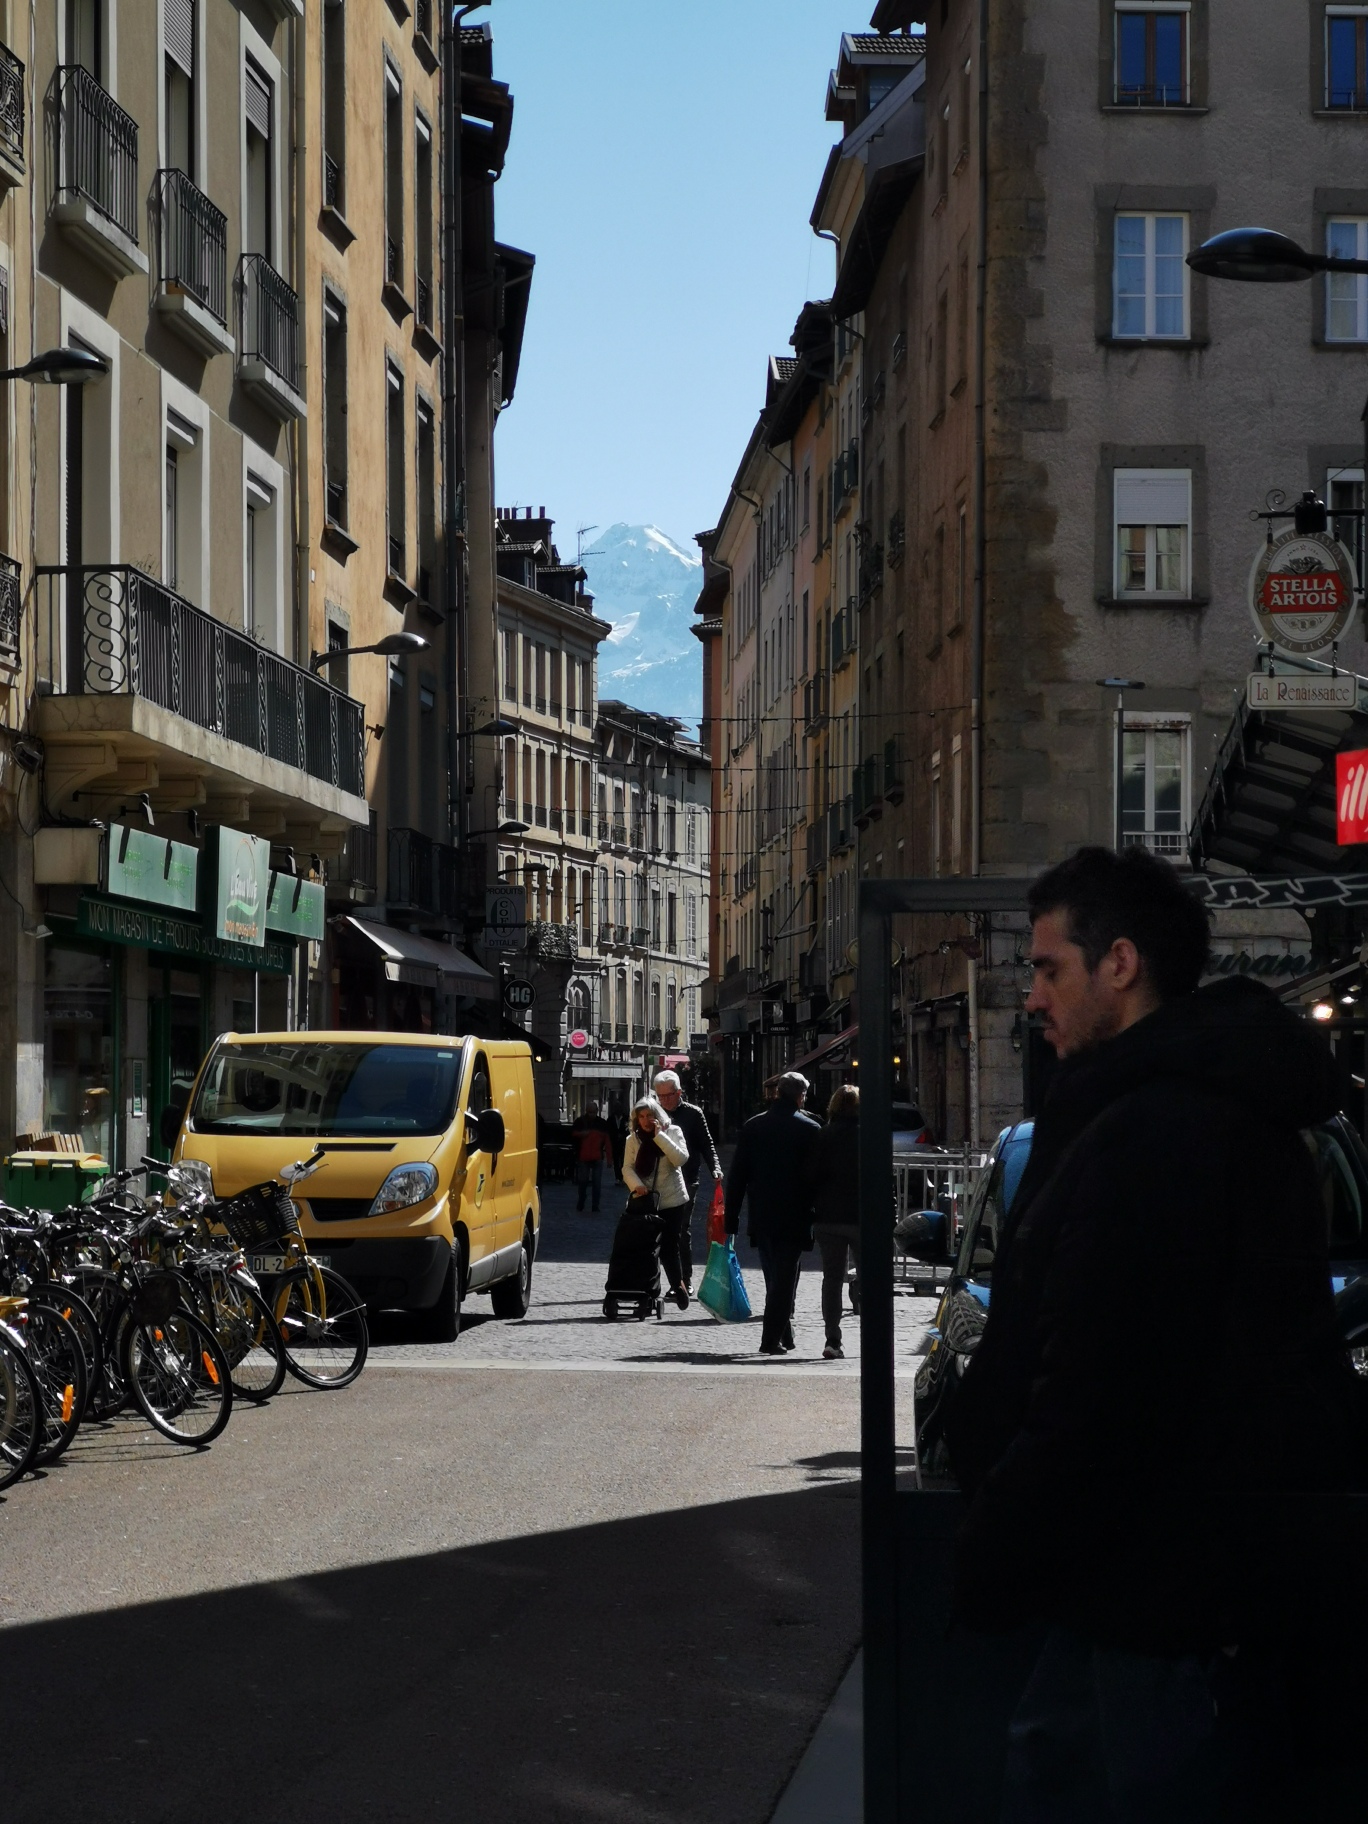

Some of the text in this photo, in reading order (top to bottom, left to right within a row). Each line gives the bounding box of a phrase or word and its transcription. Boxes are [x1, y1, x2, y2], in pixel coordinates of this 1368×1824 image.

[1270, 578, 1337, 592] STELLA
[1270, 592, 1338, 606] ARTOIS
[1256, 682, 1350, 701] La Renaissance
[1340, 763, 1368, 832] ill
[88, 902, 110, 932] MON
[113, 908, 149, 941] MAGASIN
[152, 917, 163, 944] DE
[166, 921, 200, 952] PRODUITS
[509, 986, 531, 1004] HG
